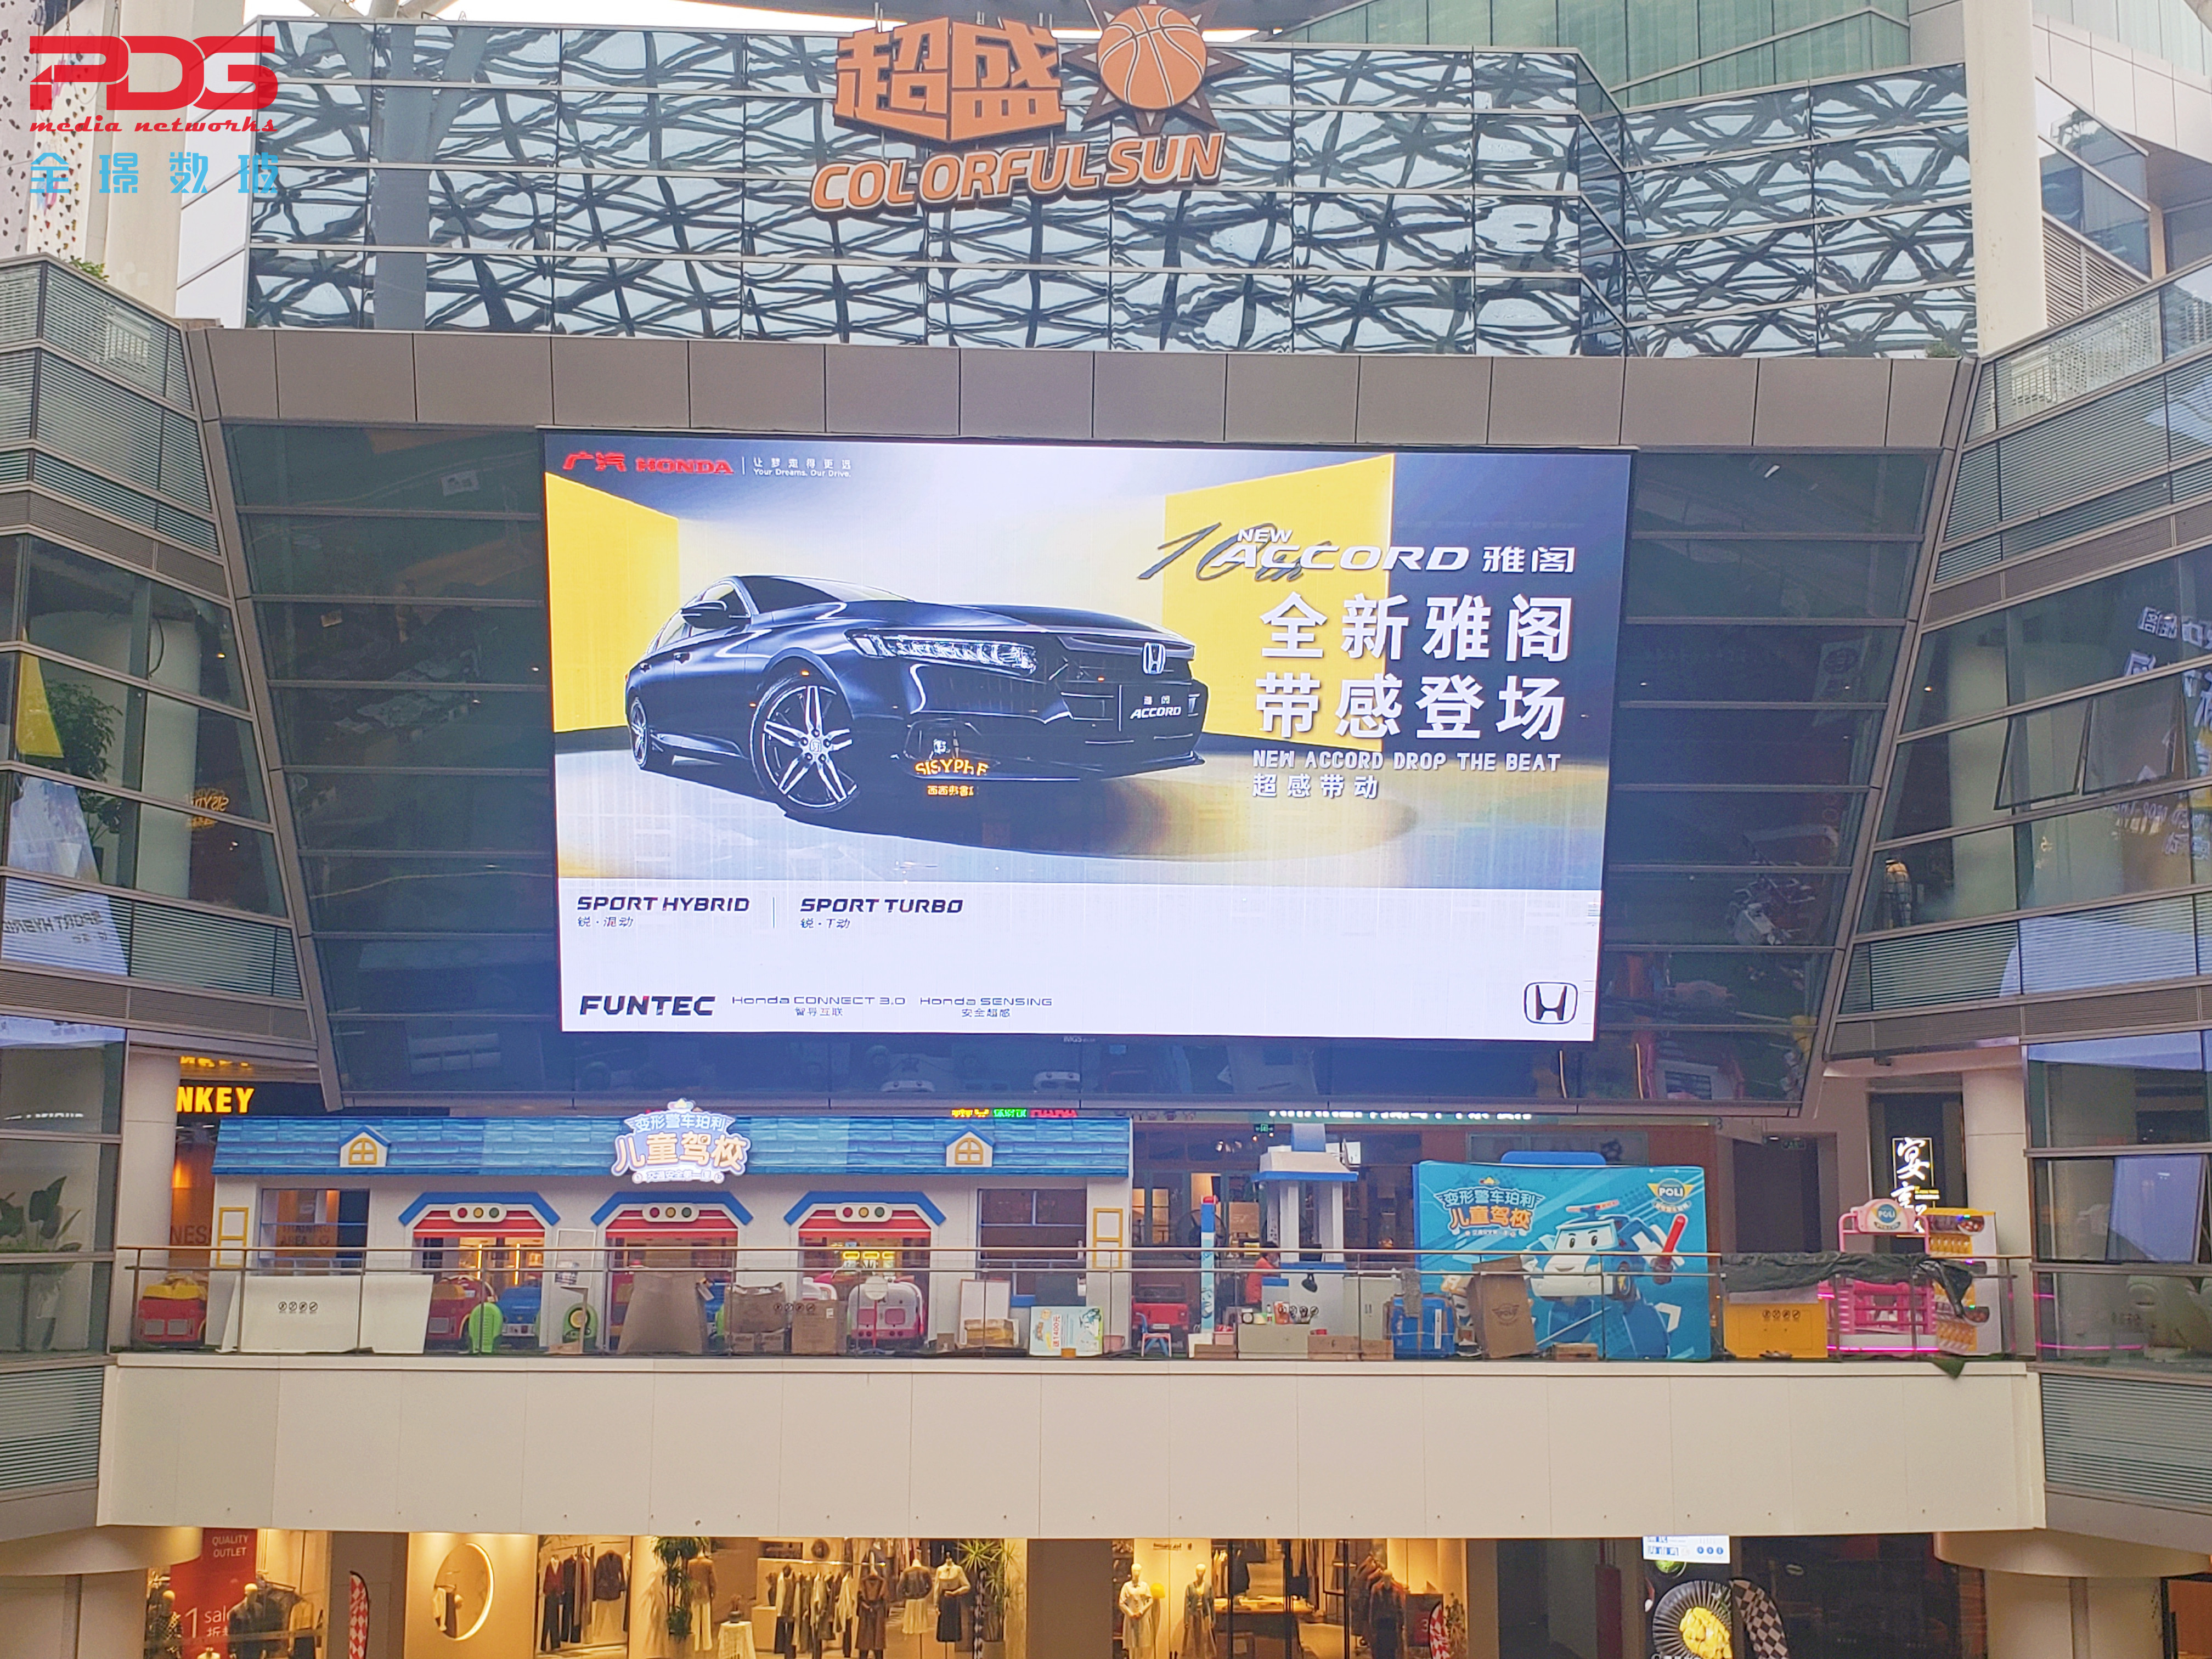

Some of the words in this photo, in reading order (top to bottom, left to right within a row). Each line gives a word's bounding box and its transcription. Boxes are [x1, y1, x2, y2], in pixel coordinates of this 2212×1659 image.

[834, 17, 1066, 142] 超盛
[812, 142, 1100, 212] COLORFUL
[1104, 131, 1226, 188] SUN
[562, 450, 627, 472] 广汽
[635, 458, 734, 475] HONDA
[753, 468, 772, 476] Your
[1237, 528, 1293, 543] NEW
[1210, 544, 1469, 572] ACCORD
[1481, 546, 1575, 573] 雅阁
[1260, 591, 1573, 662] 全新雅阁
[1130, 706, 1182, 719] ACCORD
[1255, 672, 1566, 741] 带感登场
[1253, 749, 1295, 769] NEW
[1305, 751, 1385, 770] ACCORD
[1393, 752, 1447, 770] DROP
[1457, 752, 1497, 771] THE
[1505, 753, 1562, 771] BEAT
[1252, 774, 1379, 799] 超感带动
[577, 896, 658, 911] SPORT
[662, 897, 751, 911] HYBRID
[800, 898, 879, 912] SPORT
[884, 899, 963, 913] TURBO
[579, 995, 716, 1016] FUNTEC
[732, 996, 790, 1005] Honda
[794, 996, 876, 1005] CONNECT
[879, 997, 906, 1006] 3.0
[919, 997, 977, 1006] Honda
[980, 997, 1053, 1006] SENSING
[961, 1008, 1011, 1018] 安全超感
[635, 1114, 726, 1132] 变形警车珀利
[615, 1131, 747, 1172] 儿童驾校
[1443, 1189, 1535, 1209] 变形警车珀利
[1658, 1187, 1684, 1197] POLI
[1451, 1205, 1532, 1229] 儿童驾校
[212, 1535, 248, 1545] QUALITY
[213, 1547, 246, 1557] OUTLET
[185, 1607, 198, 1638] 1
[205, 1605, 229, 1623] sal
